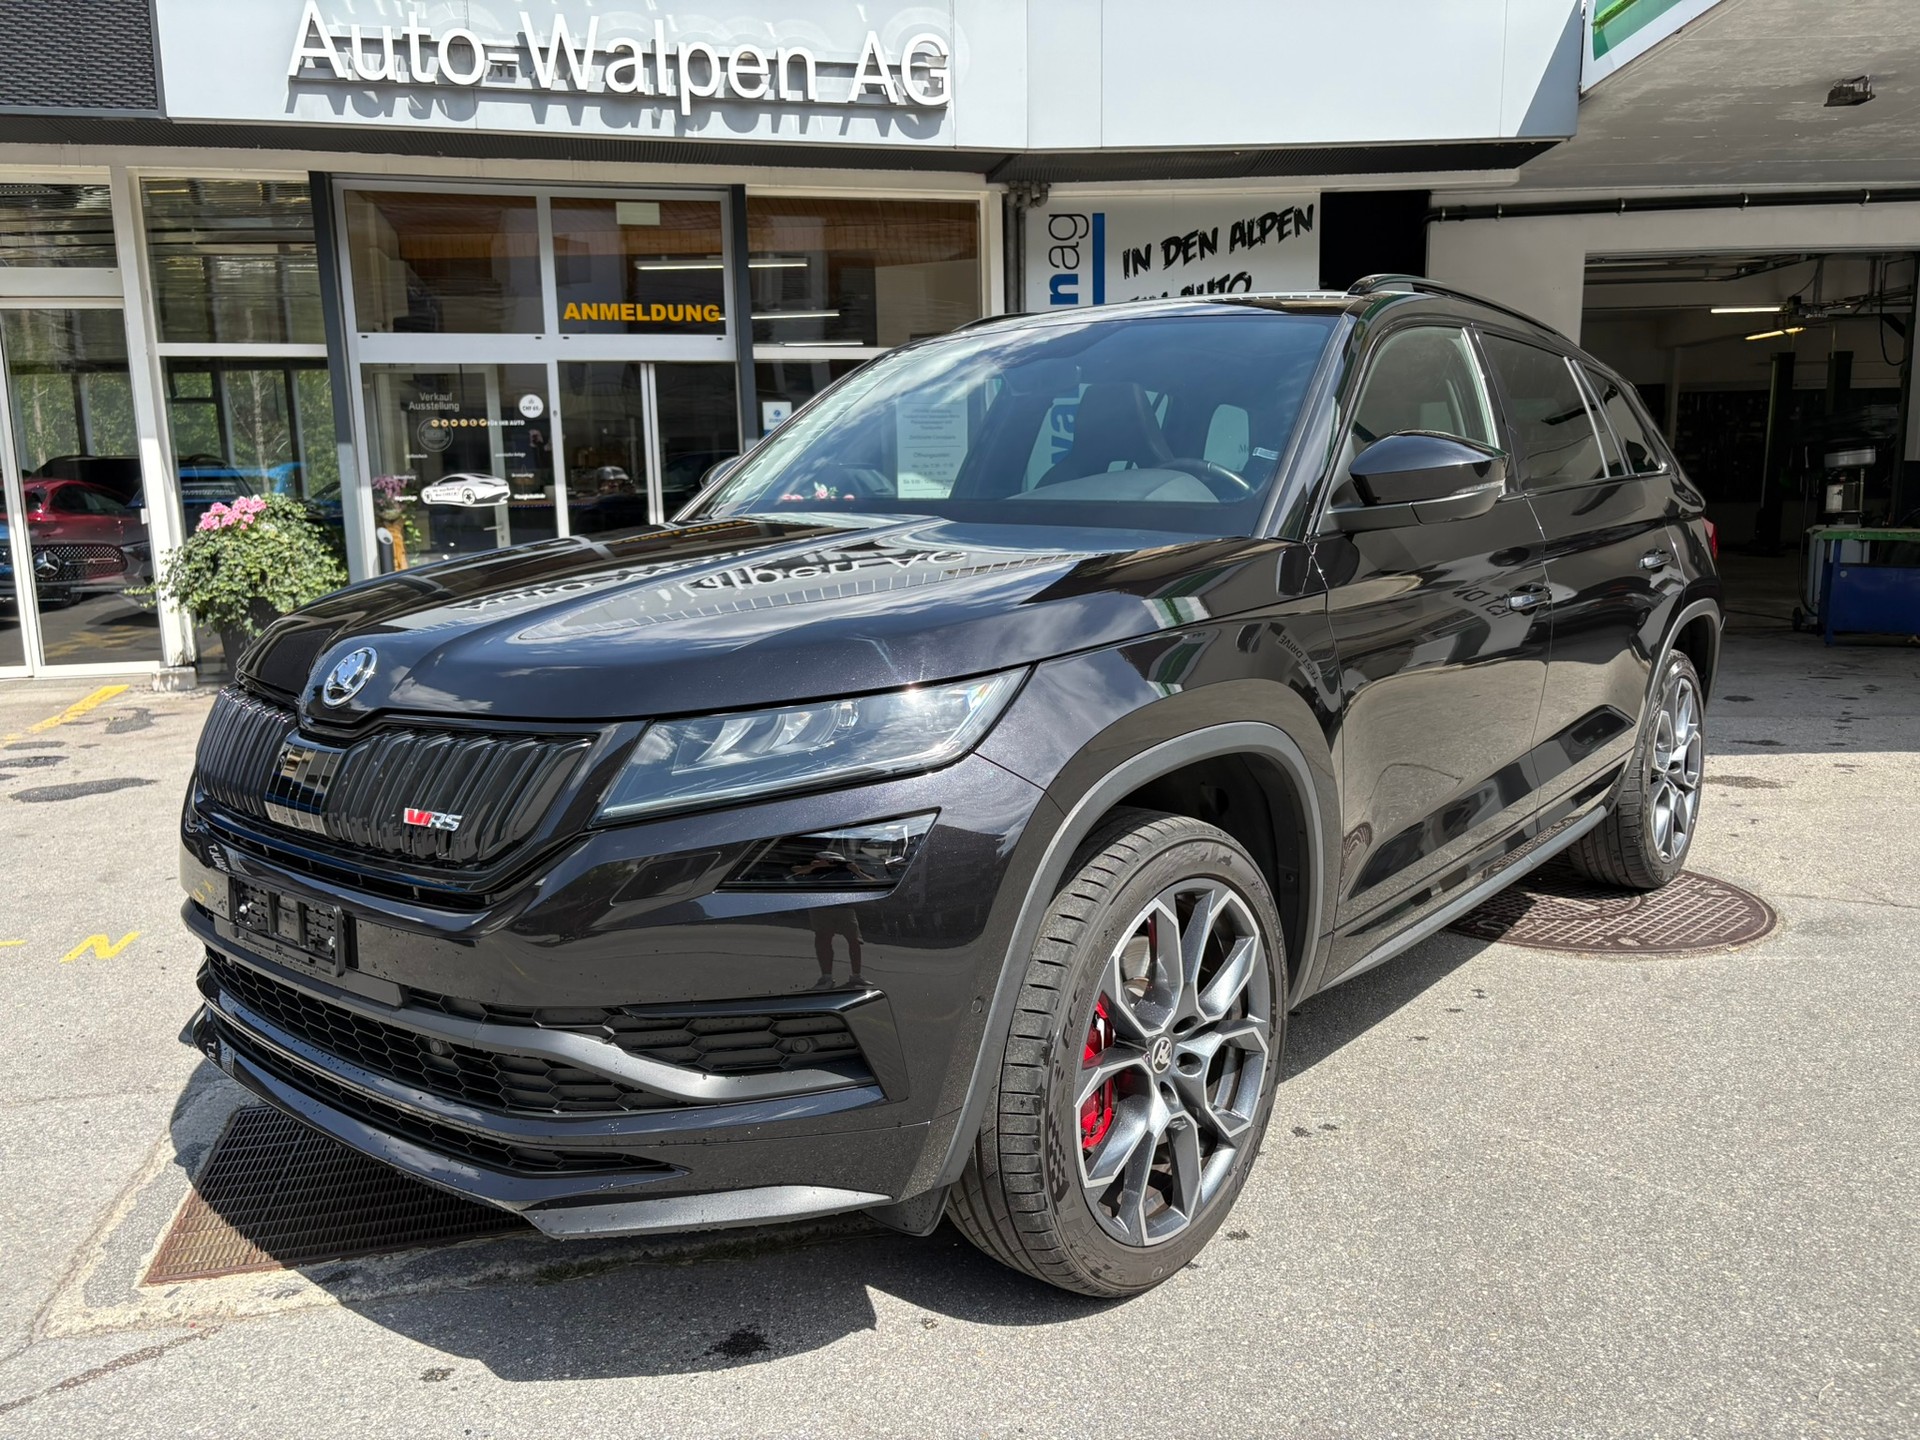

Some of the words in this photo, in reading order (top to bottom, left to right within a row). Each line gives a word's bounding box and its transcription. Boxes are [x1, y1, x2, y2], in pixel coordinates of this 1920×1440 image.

[287, 1, 818, 116] Auto-Walpen
[847, 31, 951, 106] AG
[1122, 243, 1152, 279] IN
[1161, 226, 1219, 270] DEN
[1229, 204, 1314, 255] ALPEN
[563, 303, 720, 322] ANMELDUNG
[409, 401, 460, 412] Ausstellung
[419, 392, 453, 402] Verkauf
